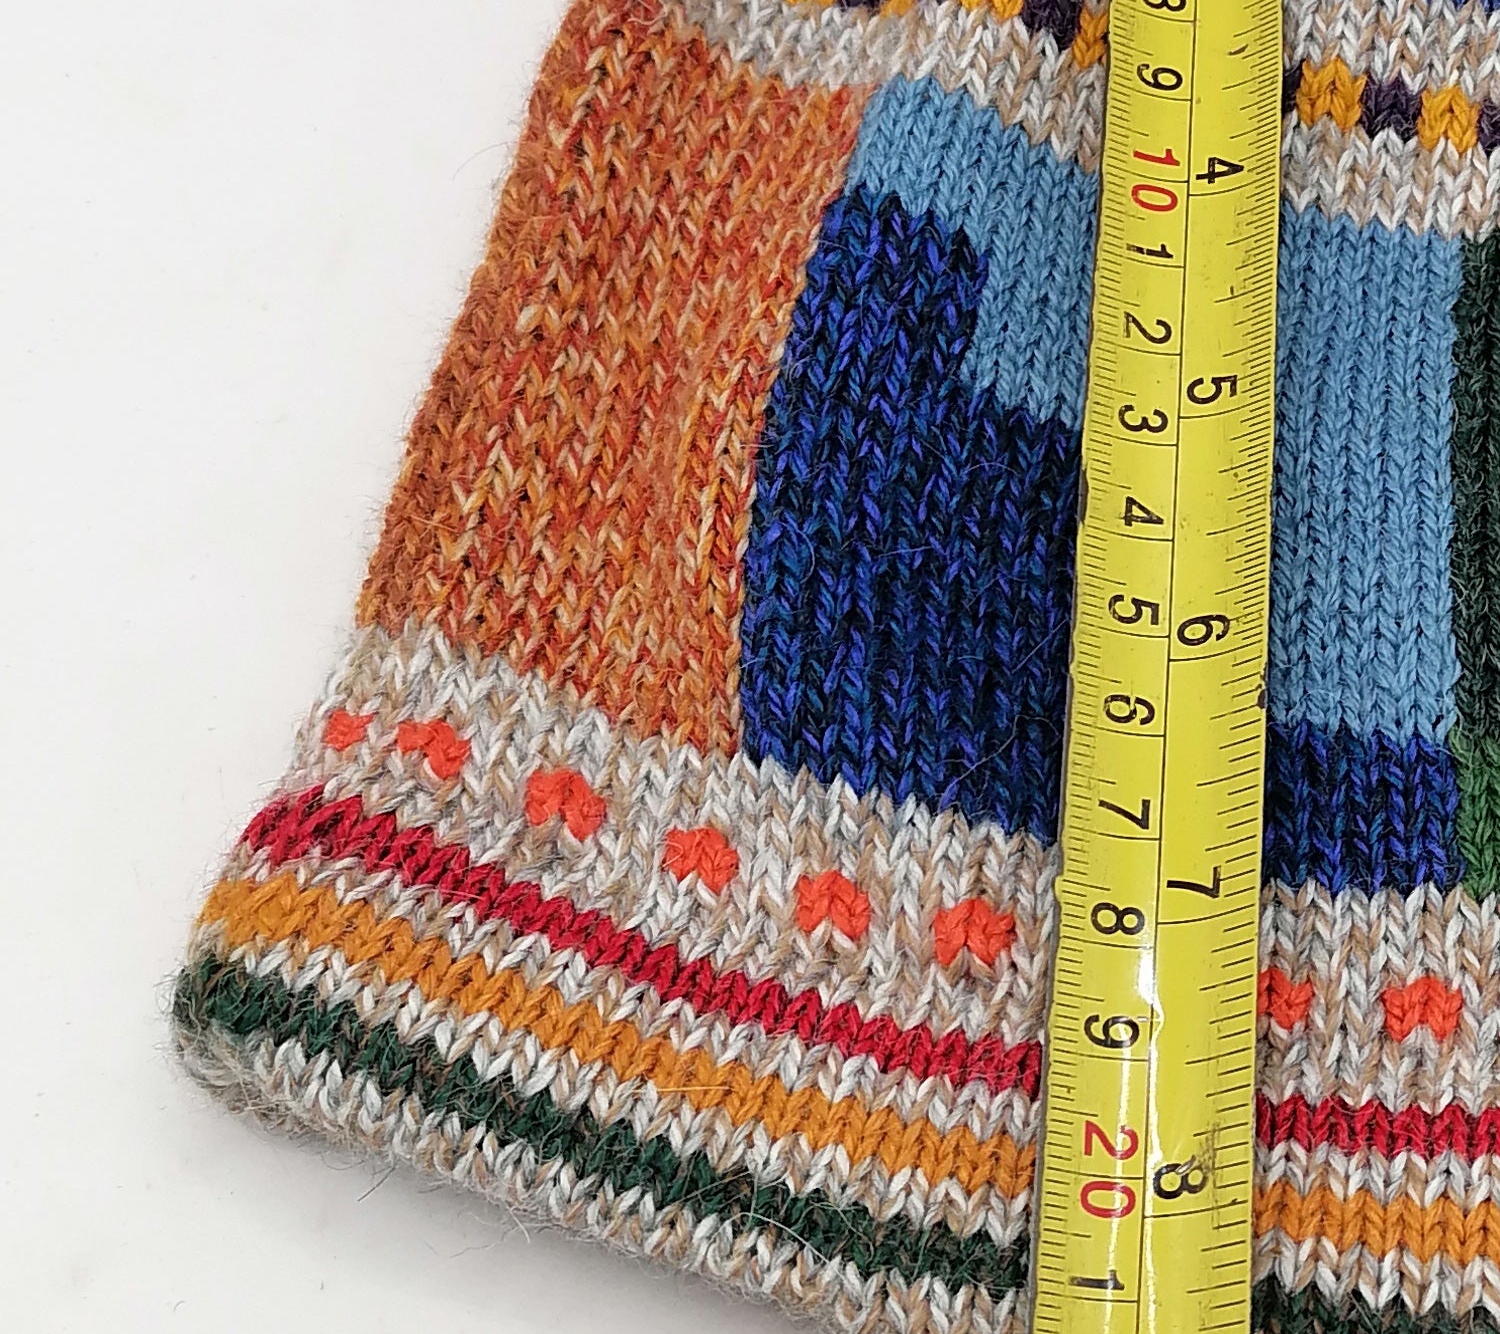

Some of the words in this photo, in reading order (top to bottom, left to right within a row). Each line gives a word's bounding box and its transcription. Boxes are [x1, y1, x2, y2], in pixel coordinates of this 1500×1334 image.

[1136, 63, 1183, 91] 9
[1131, 148, 1181, 212] 10
[1195, 156, 1245, 184] 4
[1126, 243, 1174, 259] 1
[1123, 310, 1173, 345] 2
[1186, 374, 1238, 405] 5
[1118, 404, 1169, 433] 3
[1120, 496, 1164, 528] 4
[1108, 594, 1160, 626] 5
[1177, 614, 1230, 647] 6
[1103, 694, 1155, 726] 6
[1098, 798, 1151, 831] 7
[1166, 865, 1221, 899] 7
[1090, 902, 1146, 935] 8
[1084, 1013, 1140, 1049] 9
[1079, 1120, 1139, 1219] 20
[1152, 1161, 1208, 1200] 8
[1069, 1269, 1125, 1291] 1
